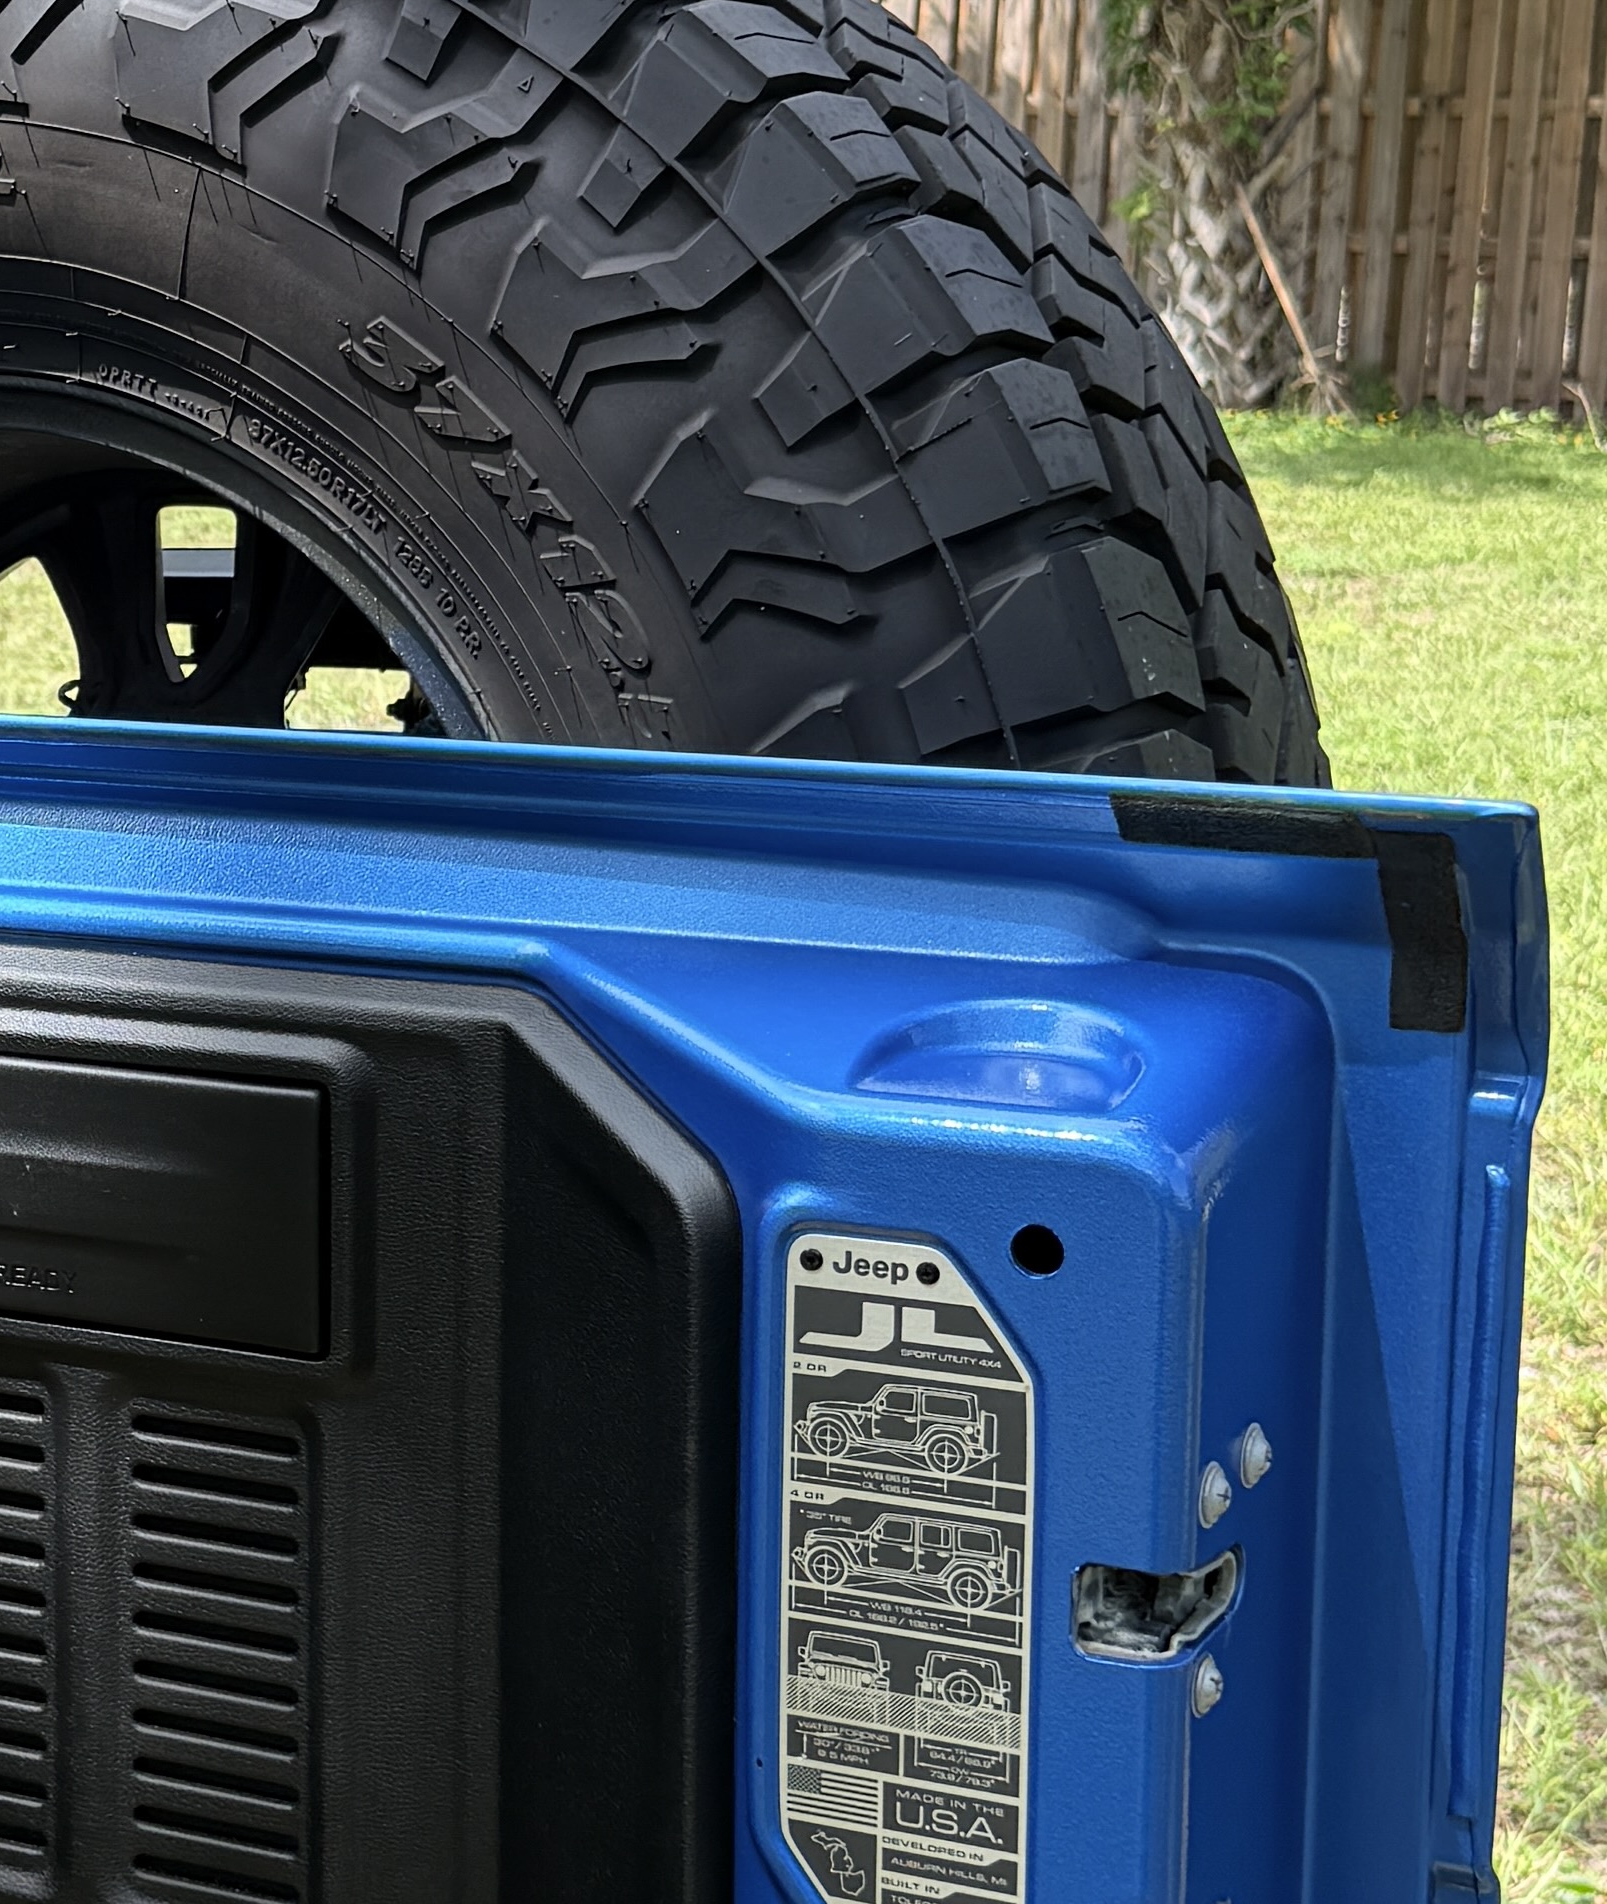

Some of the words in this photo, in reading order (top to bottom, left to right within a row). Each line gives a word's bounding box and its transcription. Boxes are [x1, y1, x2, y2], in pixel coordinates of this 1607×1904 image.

[247, 418, 387, 534] 37X12.50R17LT
[435, 588, 457, 617] 10
[832, 1250, 909, 1285] Jeep
[799, 1301, 994, 1353] JL
[806, 1364, 827, 1373] DR
[900, 1348, 937, 1361] SPORT
[938, 1353, 978, 1367] UTILITY
[790, 1489, 799, 1497] 4
[805, 1491, 825, 1501] DR
[796, 1719, 838, 1735] WATER
[839, 1726, 890, 1744] FORDING
[839, 1753, 869, 1766] MPH
[896, 1788, 947, 1806] MADE
[950, 1799, 967, 1811] IN
[972, 1803, 1005, 1817] THE
[895, 1801, 1004, 1845] U.S.A.
[881, 1836, 966, 1859] DEVELOPED
[969, 1851, 984, 1862] IN
[890, 1857, 947, 1876] AUBURN
[948, 1867, 989, 1884] HILLS,
[881, 1876, 919, 1890] BUILT
[924, 1884, 941, 1895] IN
